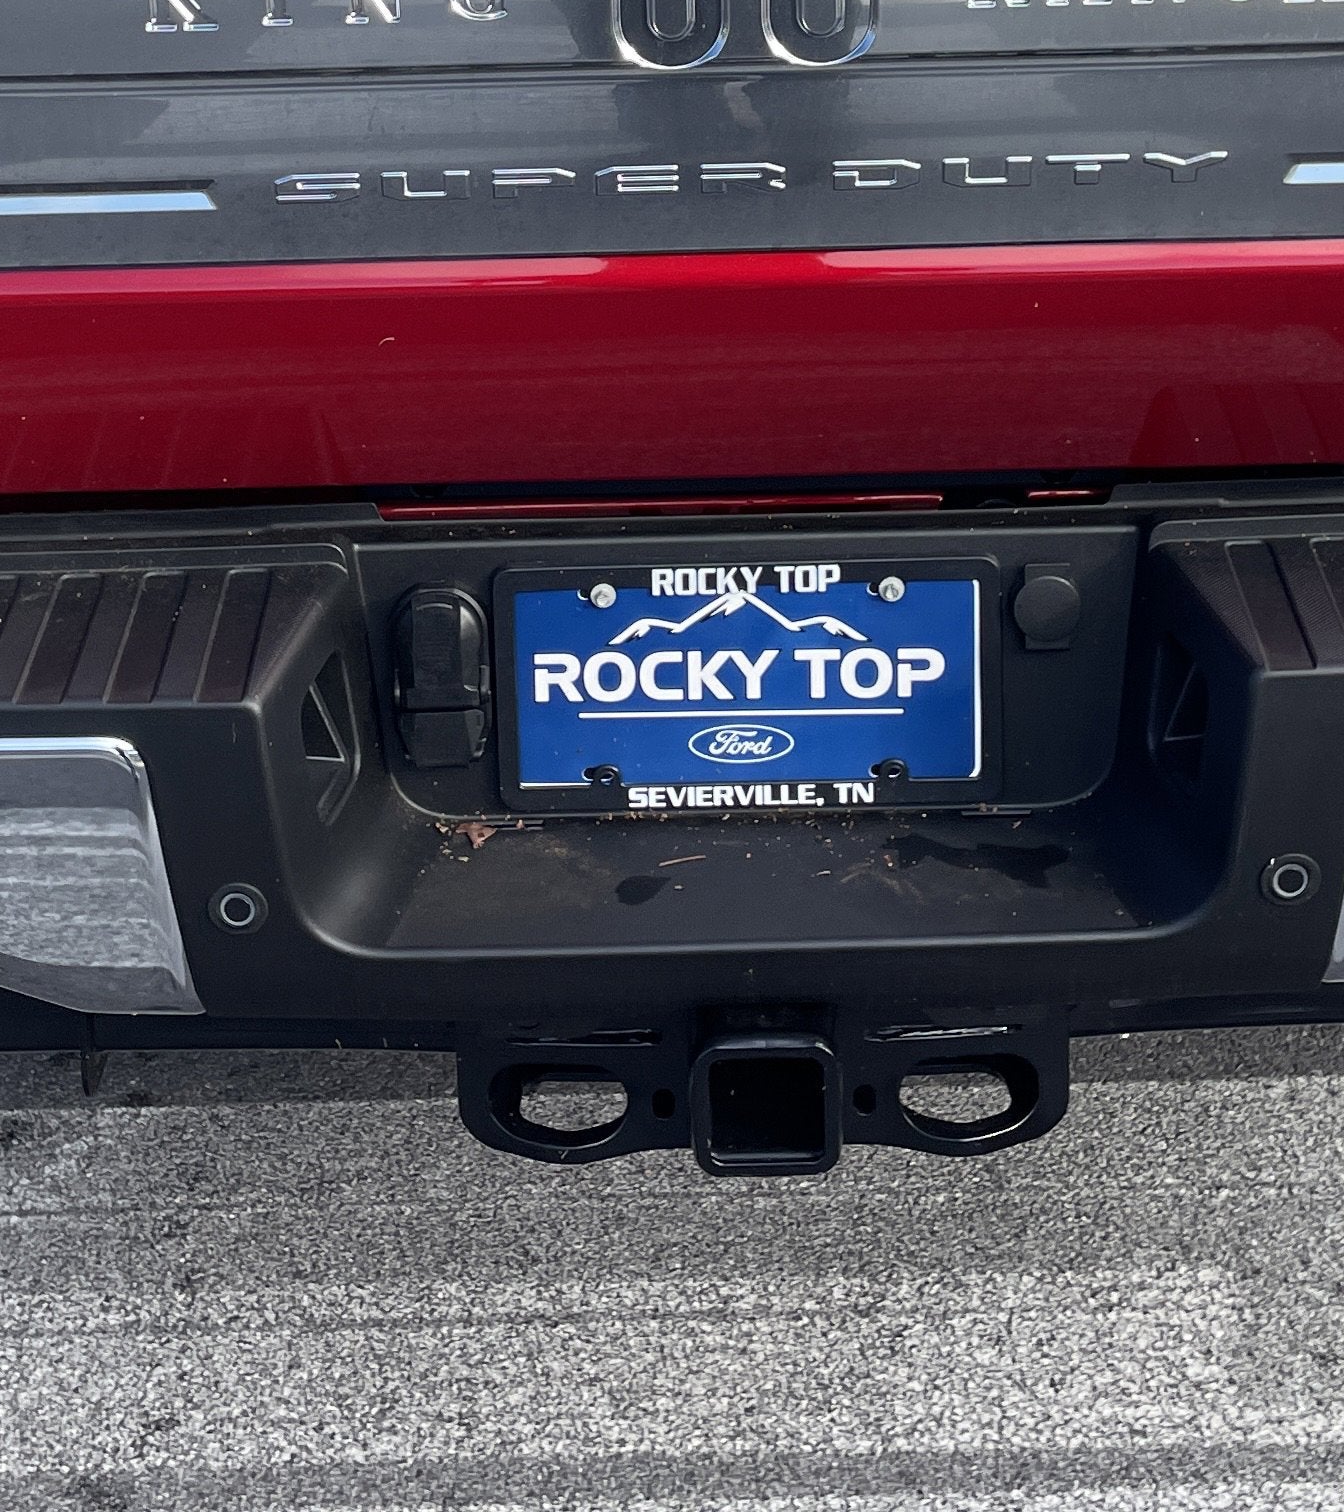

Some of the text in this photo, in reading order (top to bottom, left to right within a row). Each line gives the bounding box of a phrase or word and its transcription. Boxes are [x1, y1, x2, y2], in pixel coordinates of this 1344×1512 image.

[274, 150, 1230, 204] SUPER DUTY
[651, 563, 842, 597] ROCKY TOP
[533, 647, 946, 704] ROCKY TOP
[708, 729, 774, 756] Ford
[628, 781, 876, 809] SEVIERVILLE, TN
